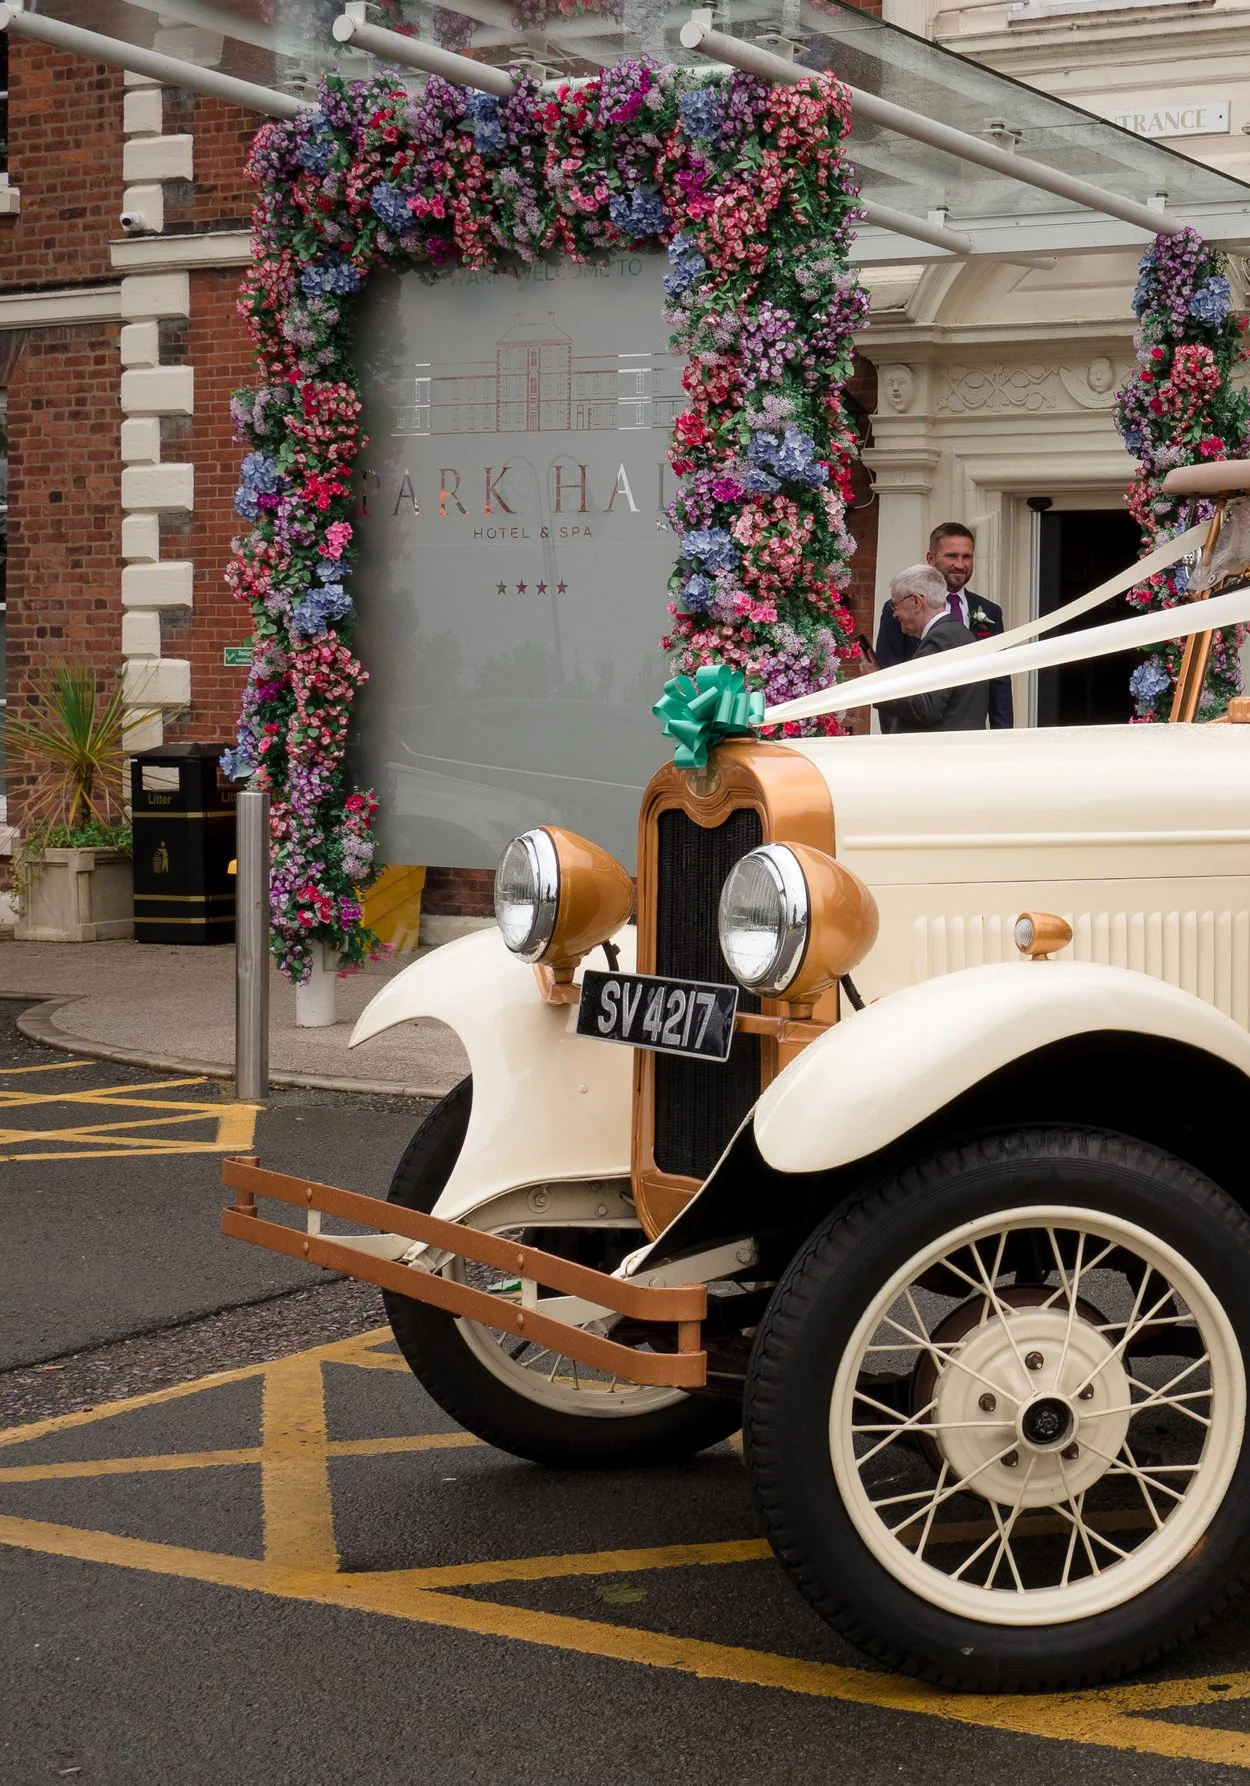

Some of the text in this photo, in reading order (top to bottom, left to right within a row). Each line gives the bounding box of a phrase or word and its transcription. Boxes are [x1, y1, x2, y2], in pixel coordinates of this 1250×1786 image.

[616, 258, 643, 277] TO
[357, 466, 517, 517] PARK
[473, 526, 593, 539] HOTEL & SPA
[148, 793, 172, 804] Litter
